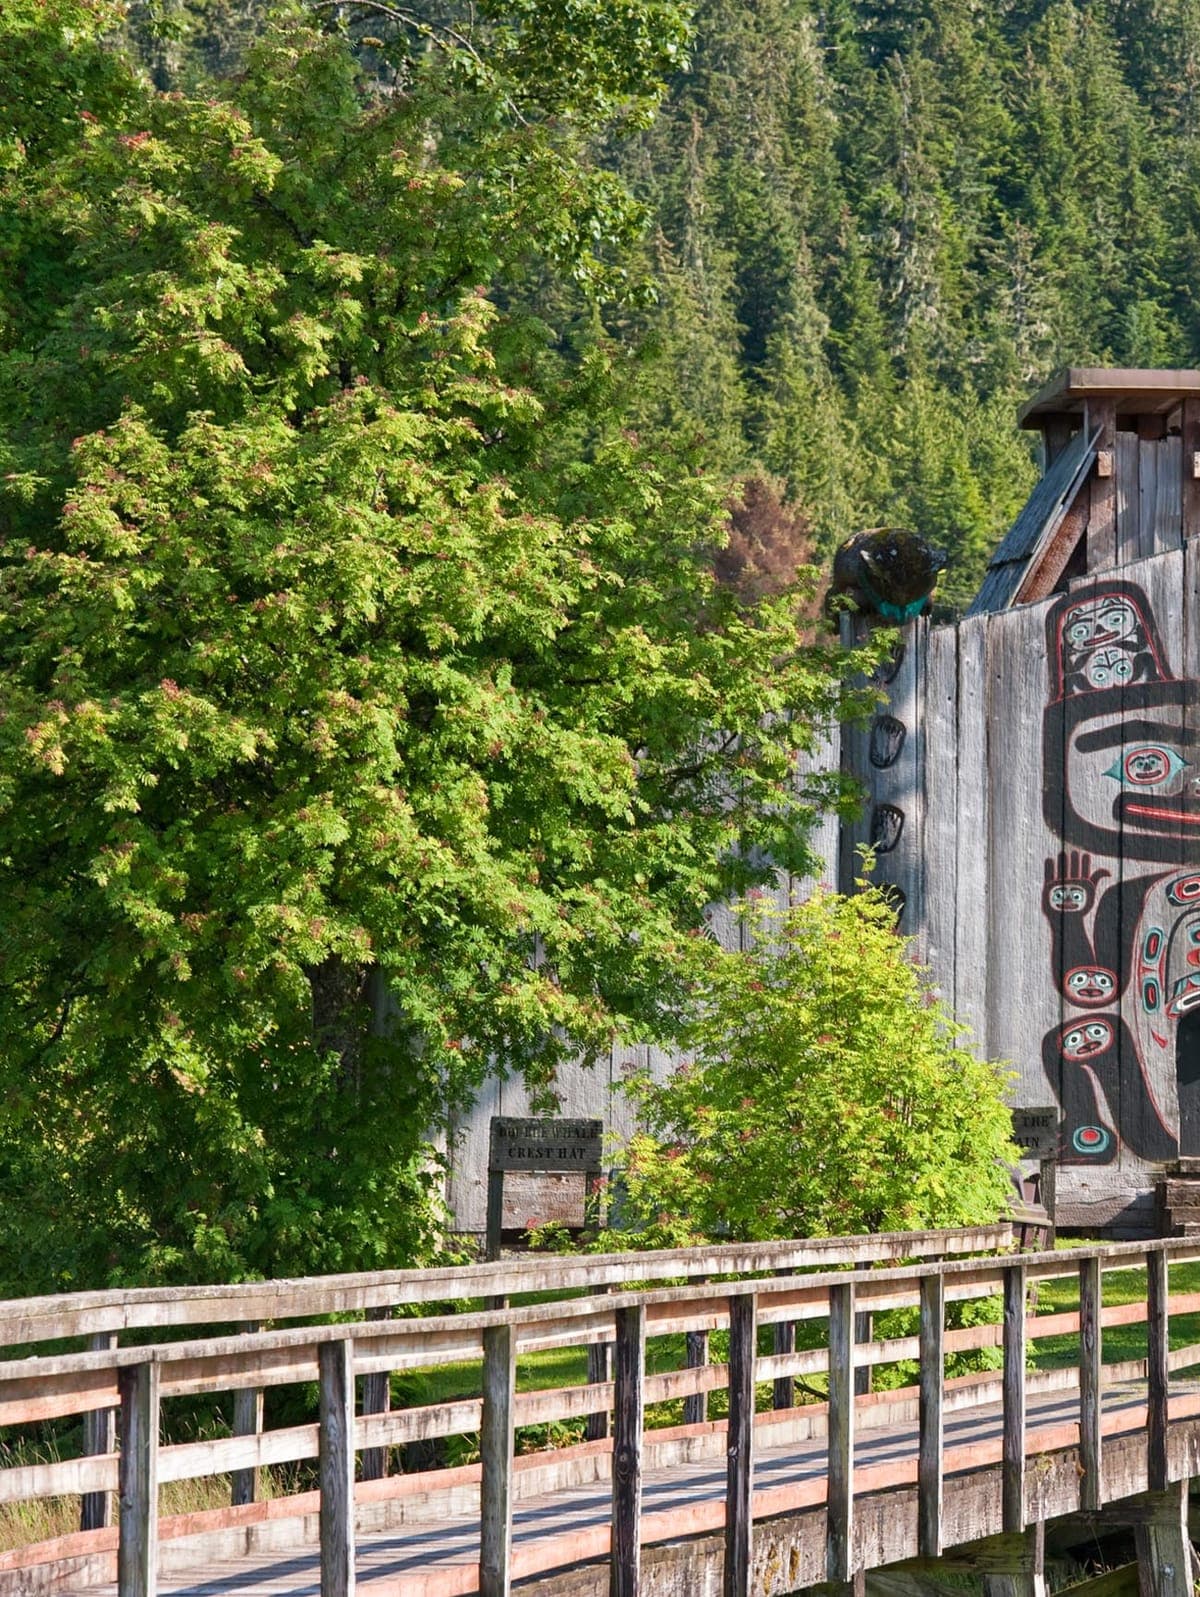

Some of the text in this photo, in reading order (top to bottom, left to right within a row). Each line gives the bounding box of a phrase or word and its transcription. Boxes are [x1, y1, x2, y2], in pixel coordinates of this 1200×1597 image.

[1023, 1115, 1049, 1127] THE
[508, 1147, 586, 1159] CREST HAT
